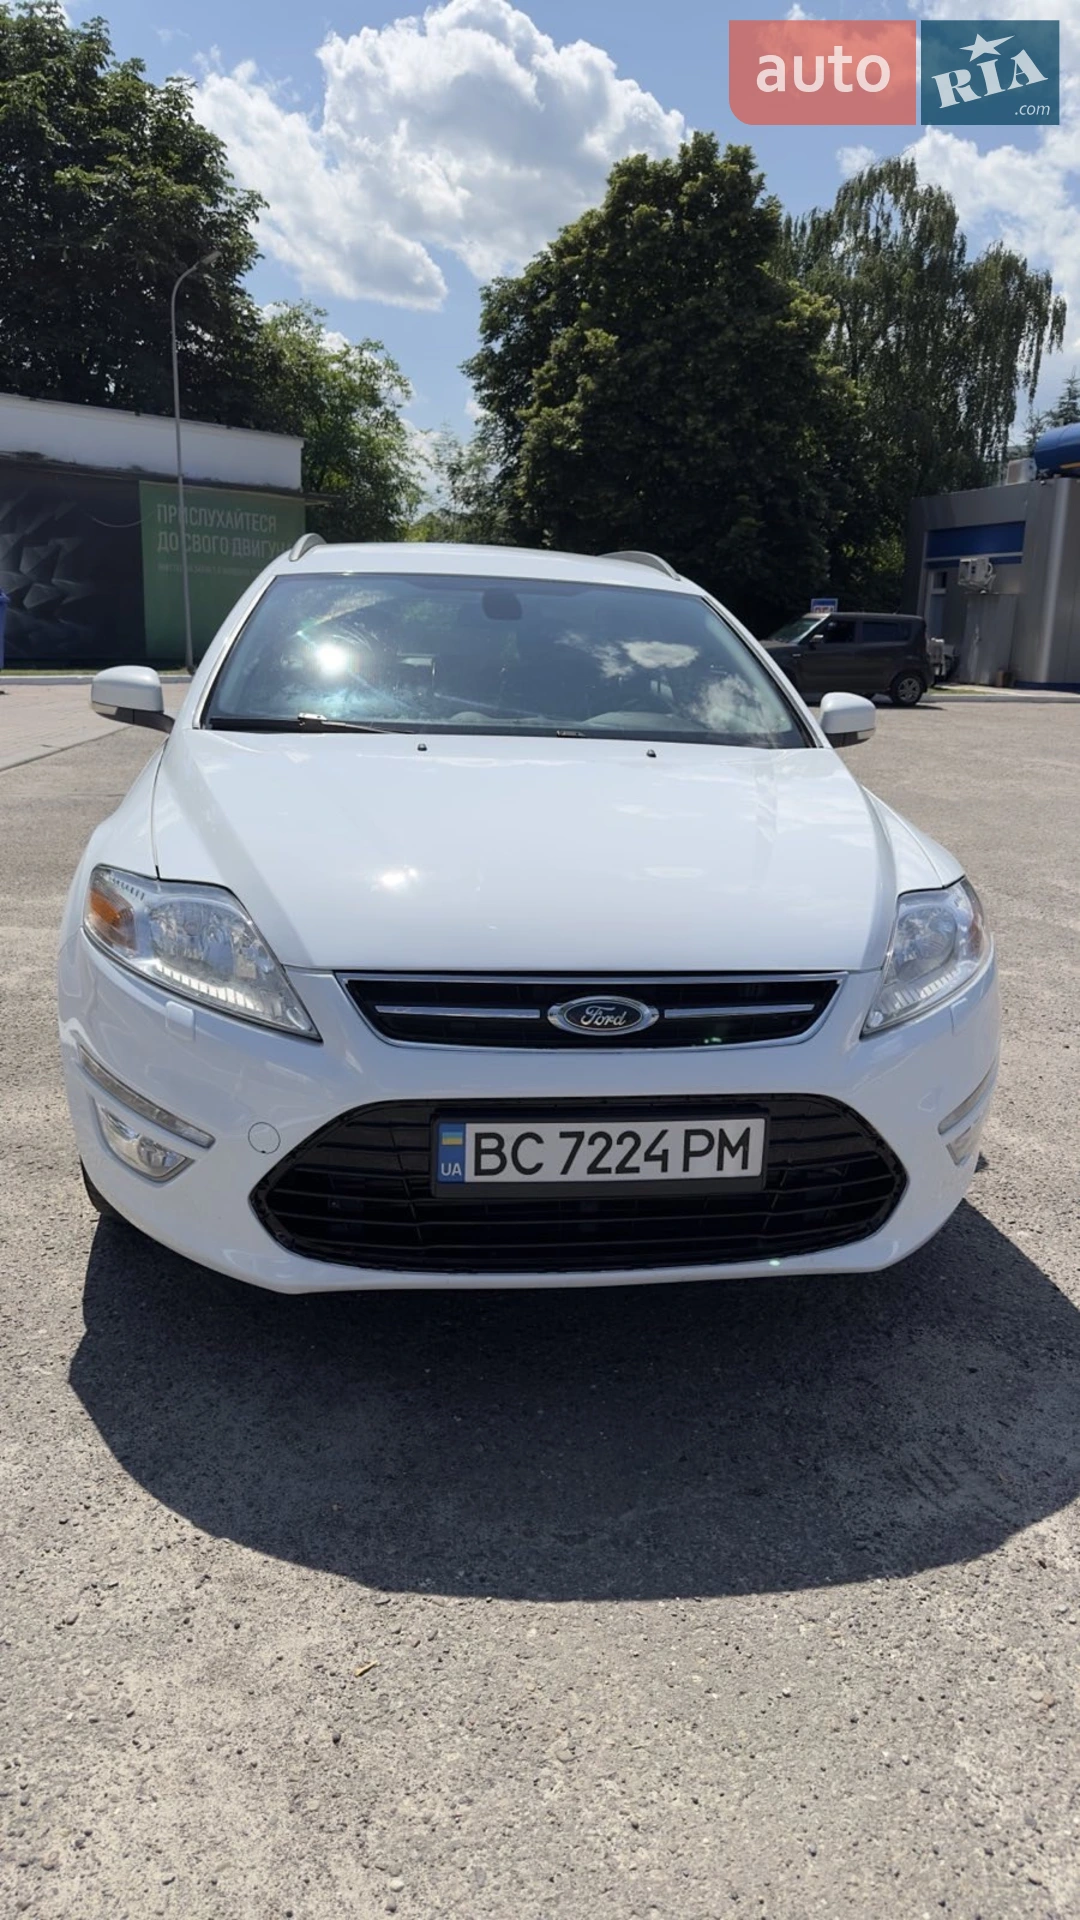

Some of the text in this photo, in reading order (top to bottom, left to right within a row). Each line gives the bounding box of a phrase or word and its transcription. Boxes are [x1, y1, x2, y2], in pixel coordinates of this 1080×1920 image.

[156, 503, 277, 534] ПРИСЛУХАЙТЕСЯ
[157, 530, 180, 554] ДО
[183, 533, 229, 556] СВОГО
[579, 1005, 628, 1026] Ford
[474, 1126, 751, 1177] BC 7224 PM
[441, 1162, 462, 1177] UA
